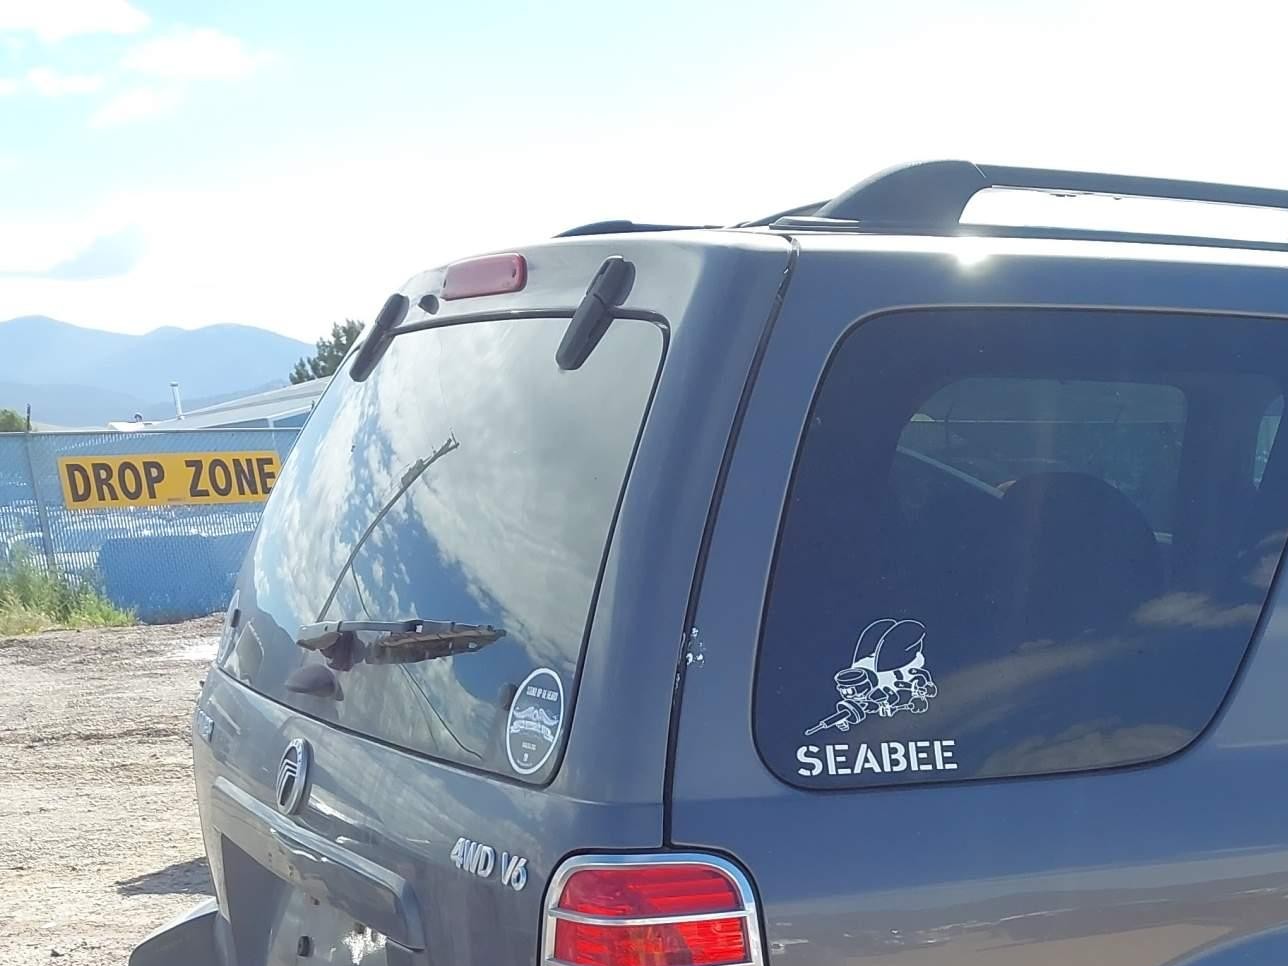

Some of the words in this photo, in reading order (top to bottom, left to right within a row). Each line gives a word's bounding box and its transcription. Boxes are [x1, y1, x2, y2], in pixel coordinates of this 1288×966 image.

[65, 460, 166, 502] DROP
[185, 458, 276, 498] ZONE
[796, 740, 958, 776] SEABEE
[450, 837, 495, 878] 4WD
[501, 851, 528, 891] V6
